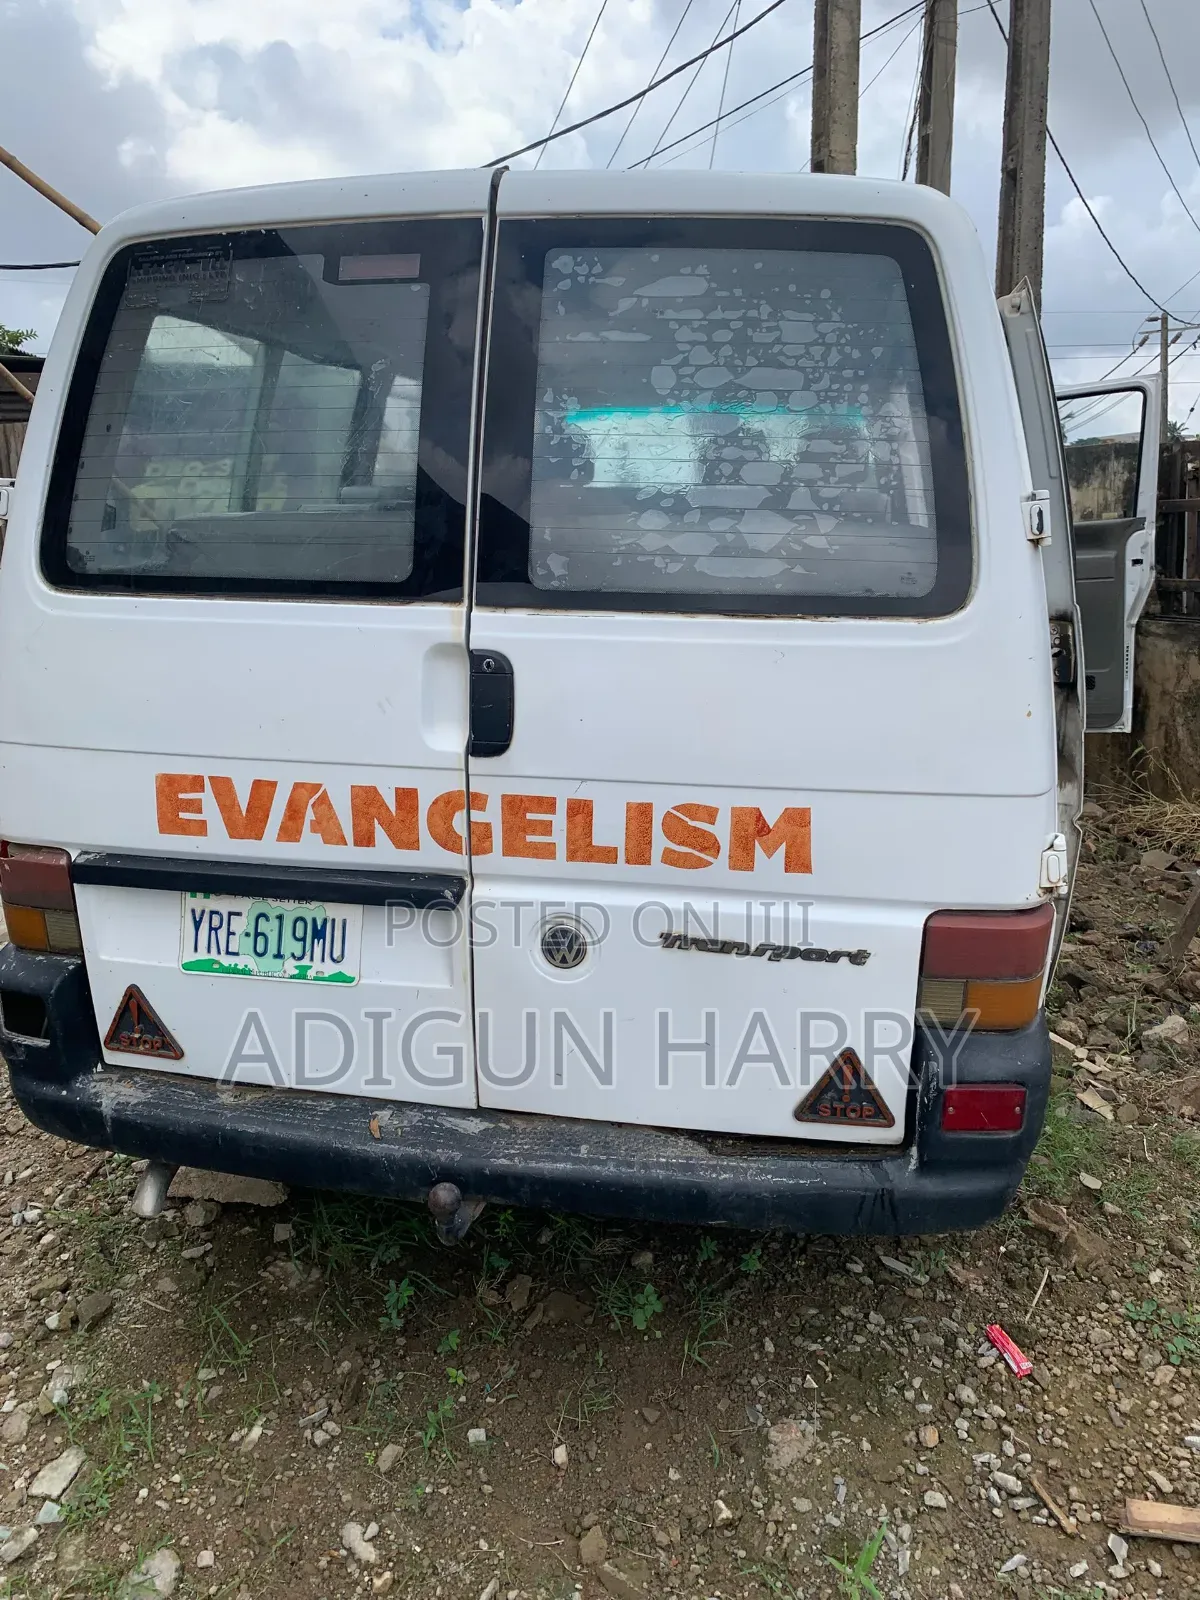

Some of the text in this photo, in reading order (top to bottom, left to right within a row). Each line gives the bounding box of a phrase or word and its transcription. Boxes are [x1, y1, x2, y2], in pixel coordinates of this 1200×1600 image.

[155, 772, 813, 875] EVANGELISM
[190, 907, 348, 964] YRE-619MU
[659, 932, 871, 966] Transport
[119, 1031, 163, 1051] STOP
[817, 1101, 875, 1119] STOP
